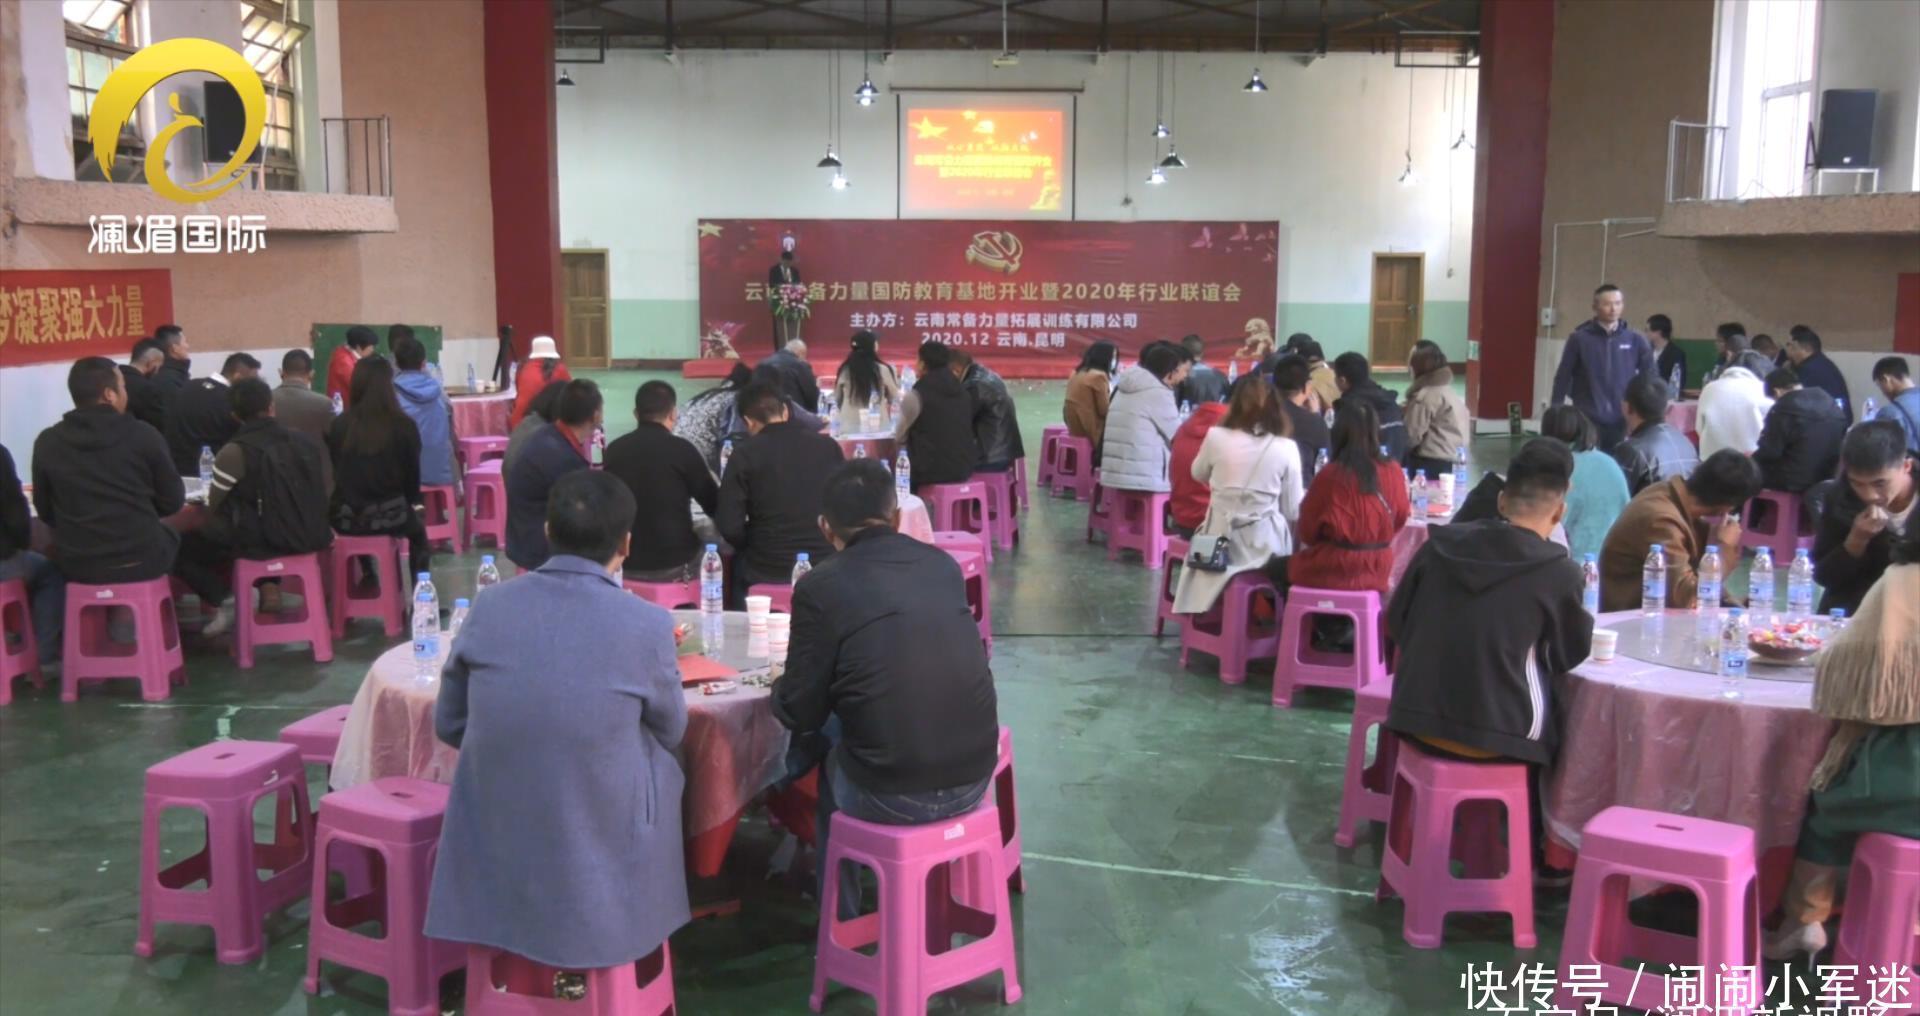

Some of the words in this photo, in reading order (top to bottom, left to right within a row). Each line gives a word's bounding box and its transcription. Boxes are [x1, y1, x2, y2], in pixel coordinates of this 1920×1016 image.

[745, 282, 1242, 302] 云备力量国防教育基地开业暨2020年行业联谊会
